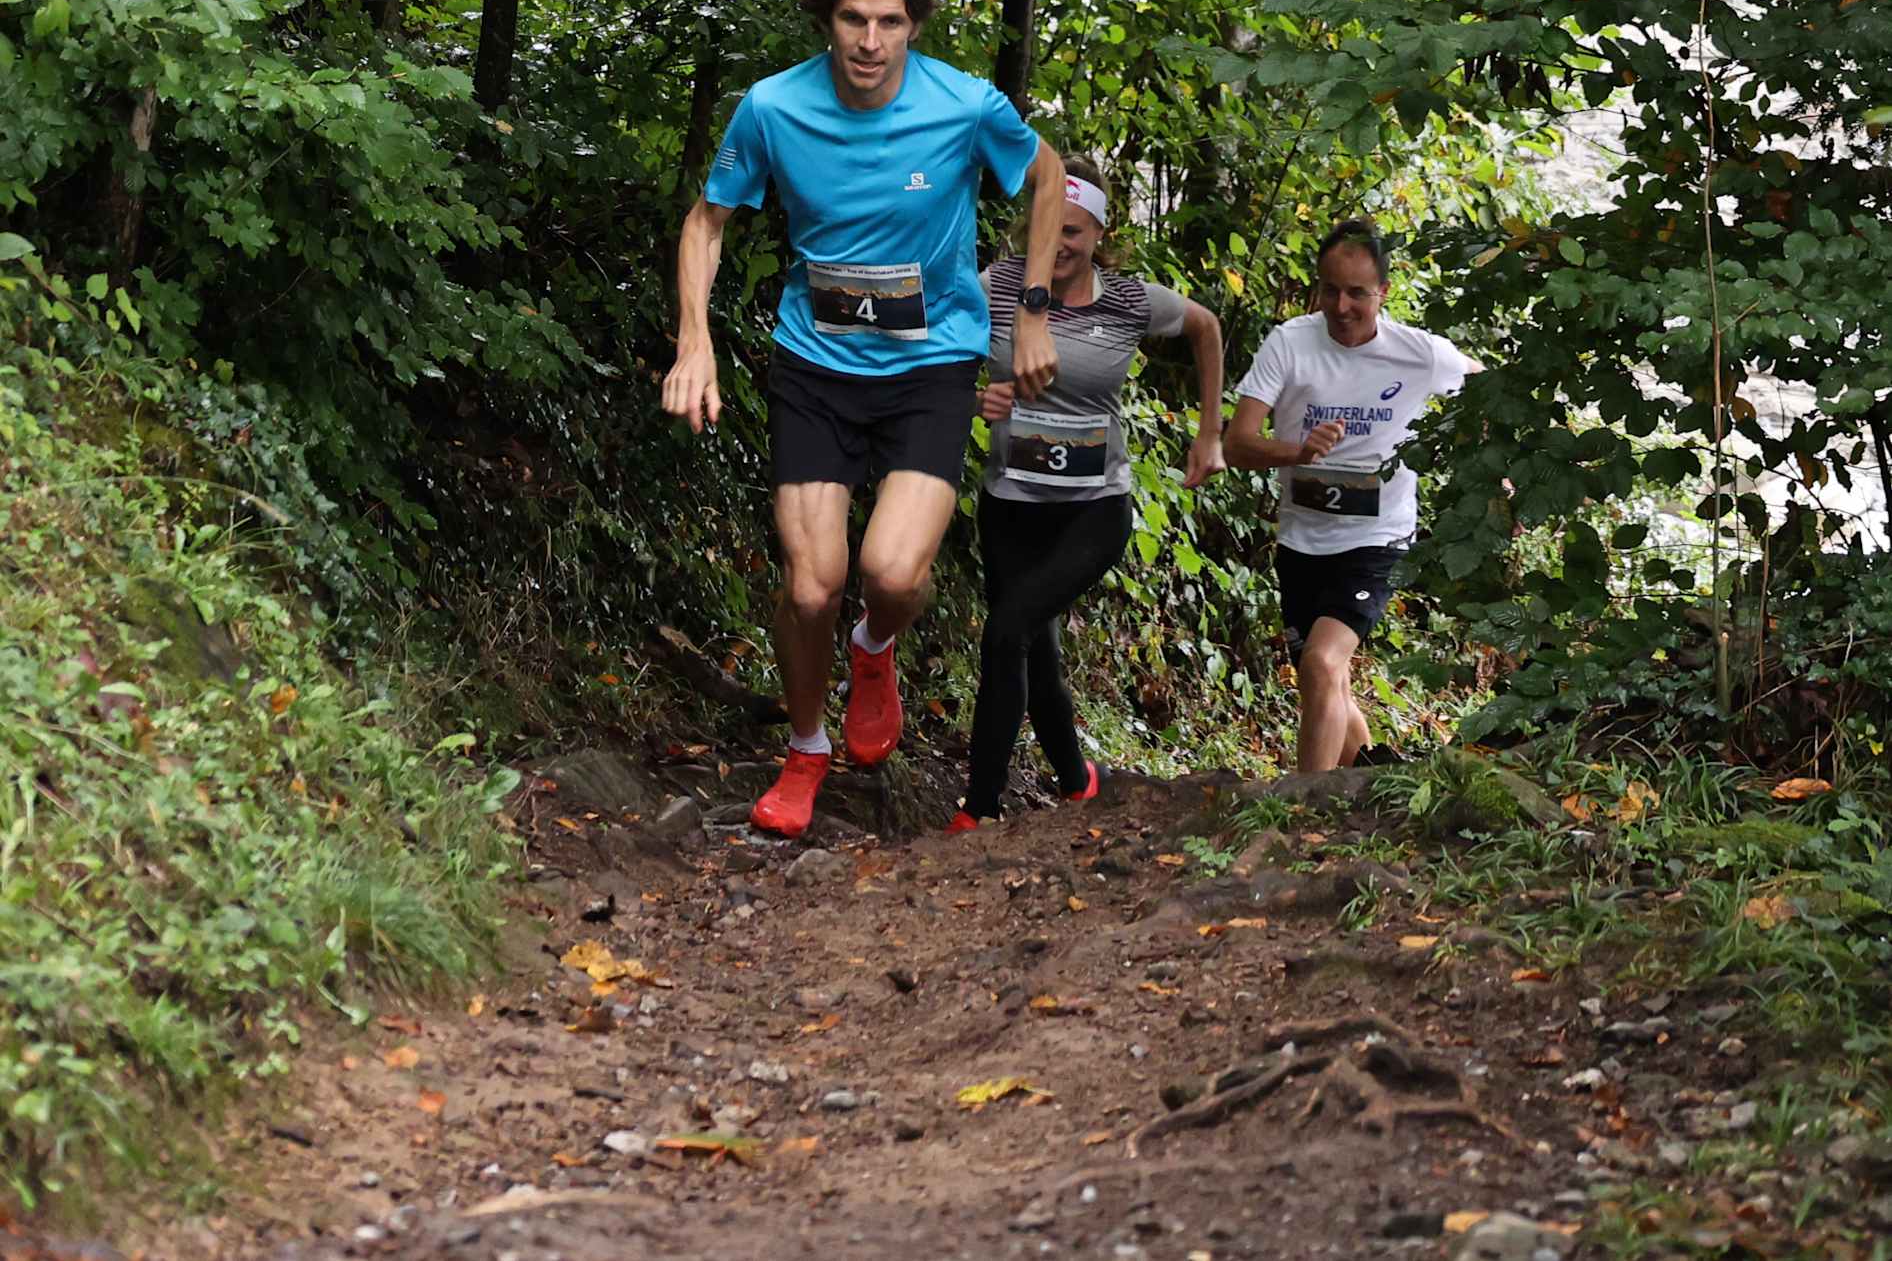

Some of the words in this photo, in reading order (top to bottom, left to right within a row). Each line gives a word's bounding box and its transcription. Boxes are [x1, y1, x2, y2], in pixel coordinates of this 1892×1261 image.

[856, 298, 878, 323] 4
[1305, 404, 1393, 422] SWITZERLAND
[1048, 445, 1068, 471] 3
[1326, 487, 1342, 510] 2
